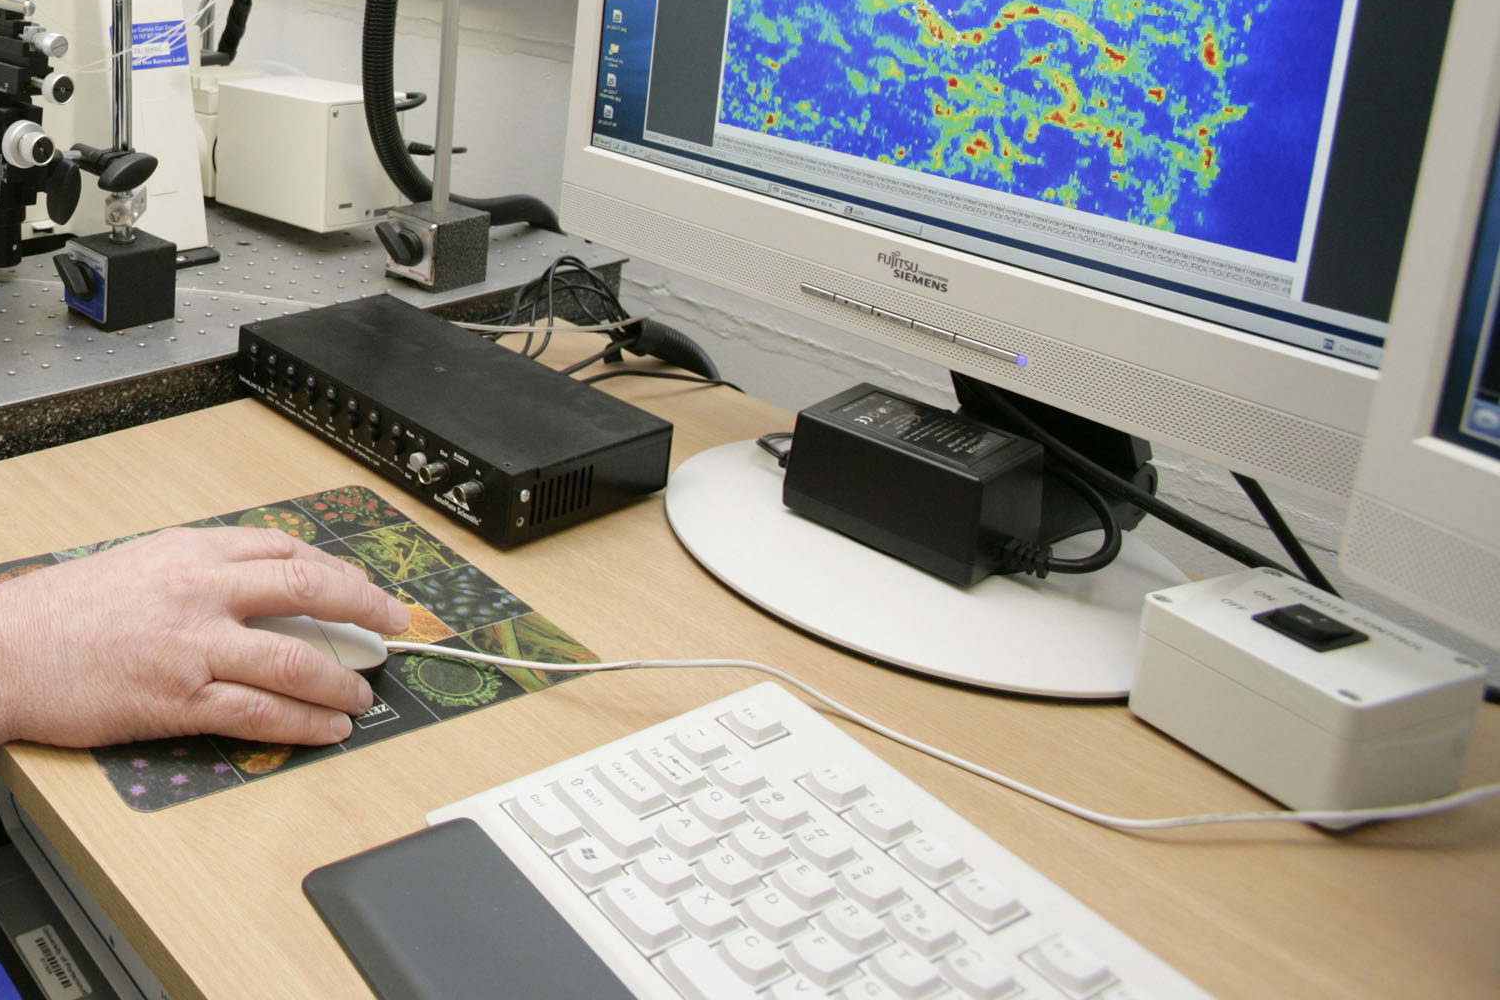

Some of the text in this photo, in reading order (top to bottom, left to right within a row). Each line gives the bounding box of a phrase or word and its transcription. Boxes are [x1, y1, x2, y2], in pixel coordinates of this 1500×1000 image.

[878, 251, 919, 273] FUJITSU
[893, 268, 948, 293] SIEMENS
[1253, 589, 1277, 602] ON
[1220, 597, 1249, 612] OFF
[1287, 585, 1424, 652] REMOTE CONTROL
[355, 703, 390, 720] ZEI
[583, 787, 605, 807] Shift
[679, 818, 693, 829] A
[752, 826, 772, 841] W
[658, 854, 674, 864] Z
[722, 854, 735, 866] S
[796, 864, 811, 875] E
[699, 892, 716, 904] X
[764, 893, 780, 905] D
[843, 904, 860, 917] R
[744, 935, 760, 948] C
[812, 936, 828, 946] F
[794, 979, 810, 994] V
[864, 981, 882, 997] G
